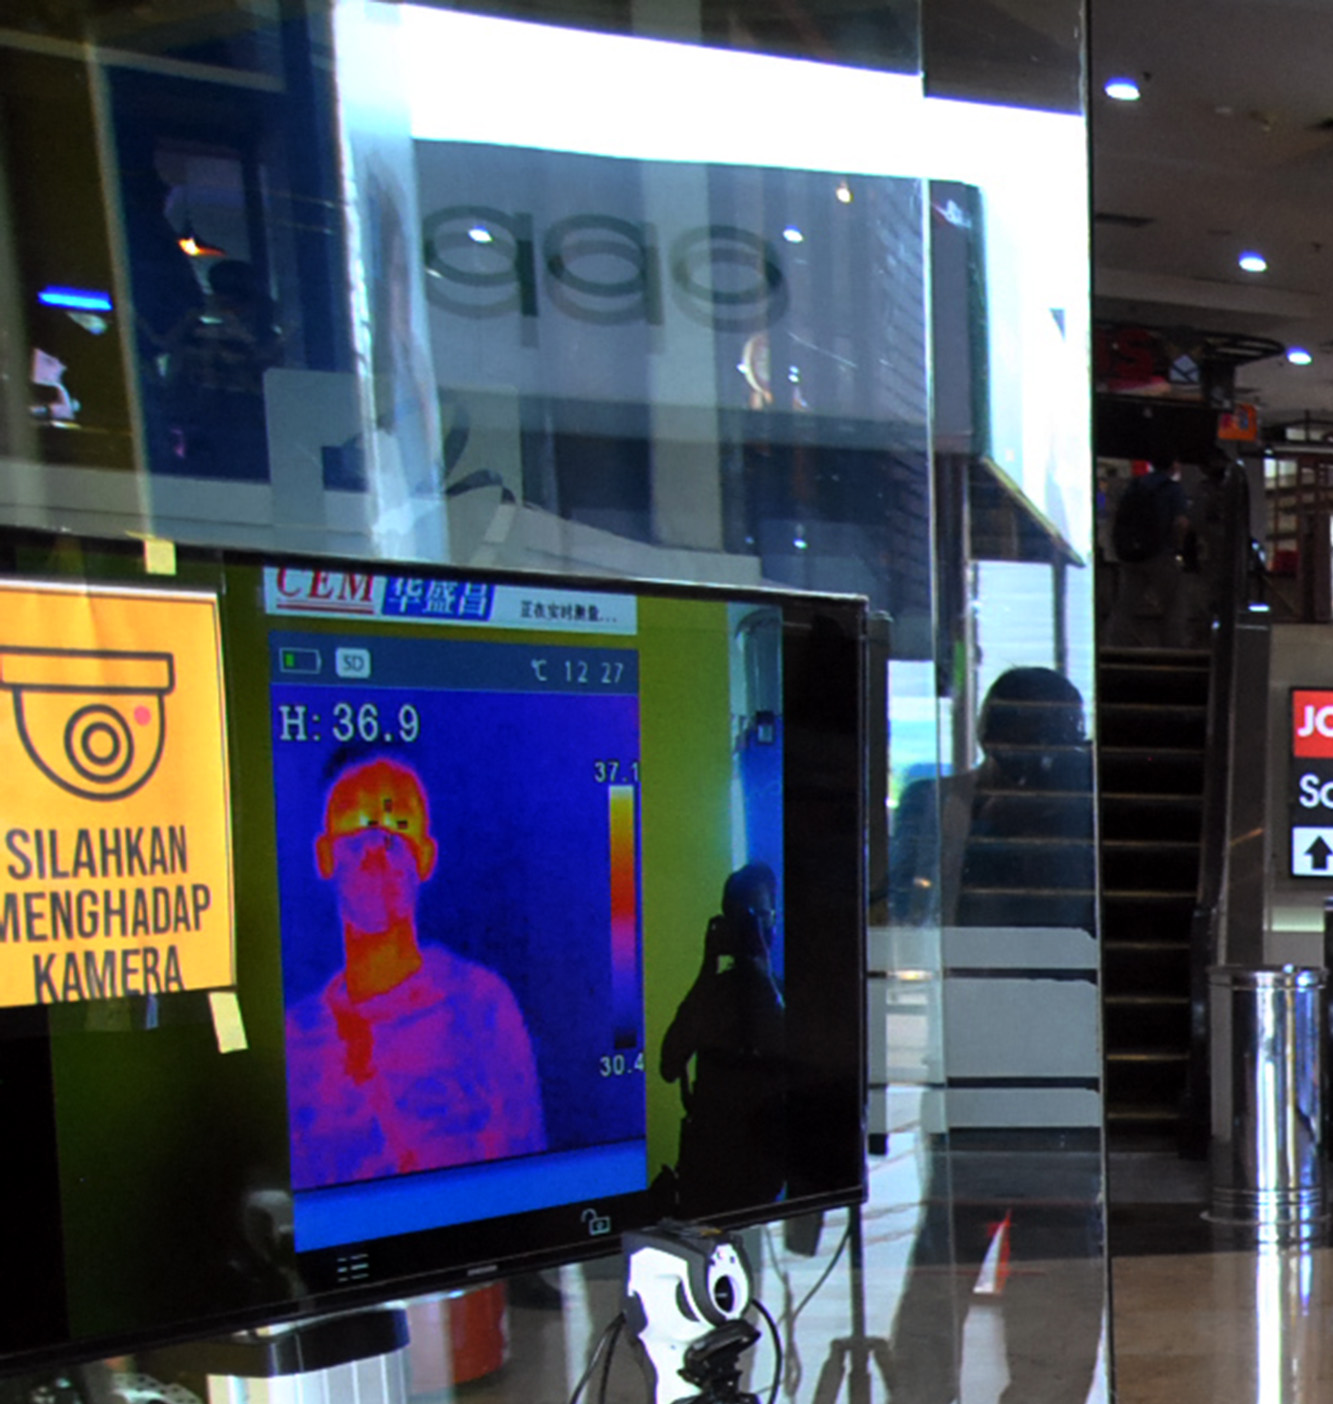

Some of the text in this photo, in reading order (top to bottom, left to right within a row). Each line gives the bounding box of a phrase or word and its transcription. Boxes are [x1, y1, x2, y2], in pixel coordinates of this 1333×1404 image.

[276, 567, 374, 602] CEM
[343, 654, 364, 671] SD
[565, 660, 588, 683] 12
[601, 662, 624, 684] 27
[332, 703, 420, 742] 36.9
[594, 761, 639, 782] 37.1
[5, 825, 188, 880] SILAHKAN
[0, 884, 211, 943] MENGHADAP
[33, 945, 185, 1003] KAMERA
